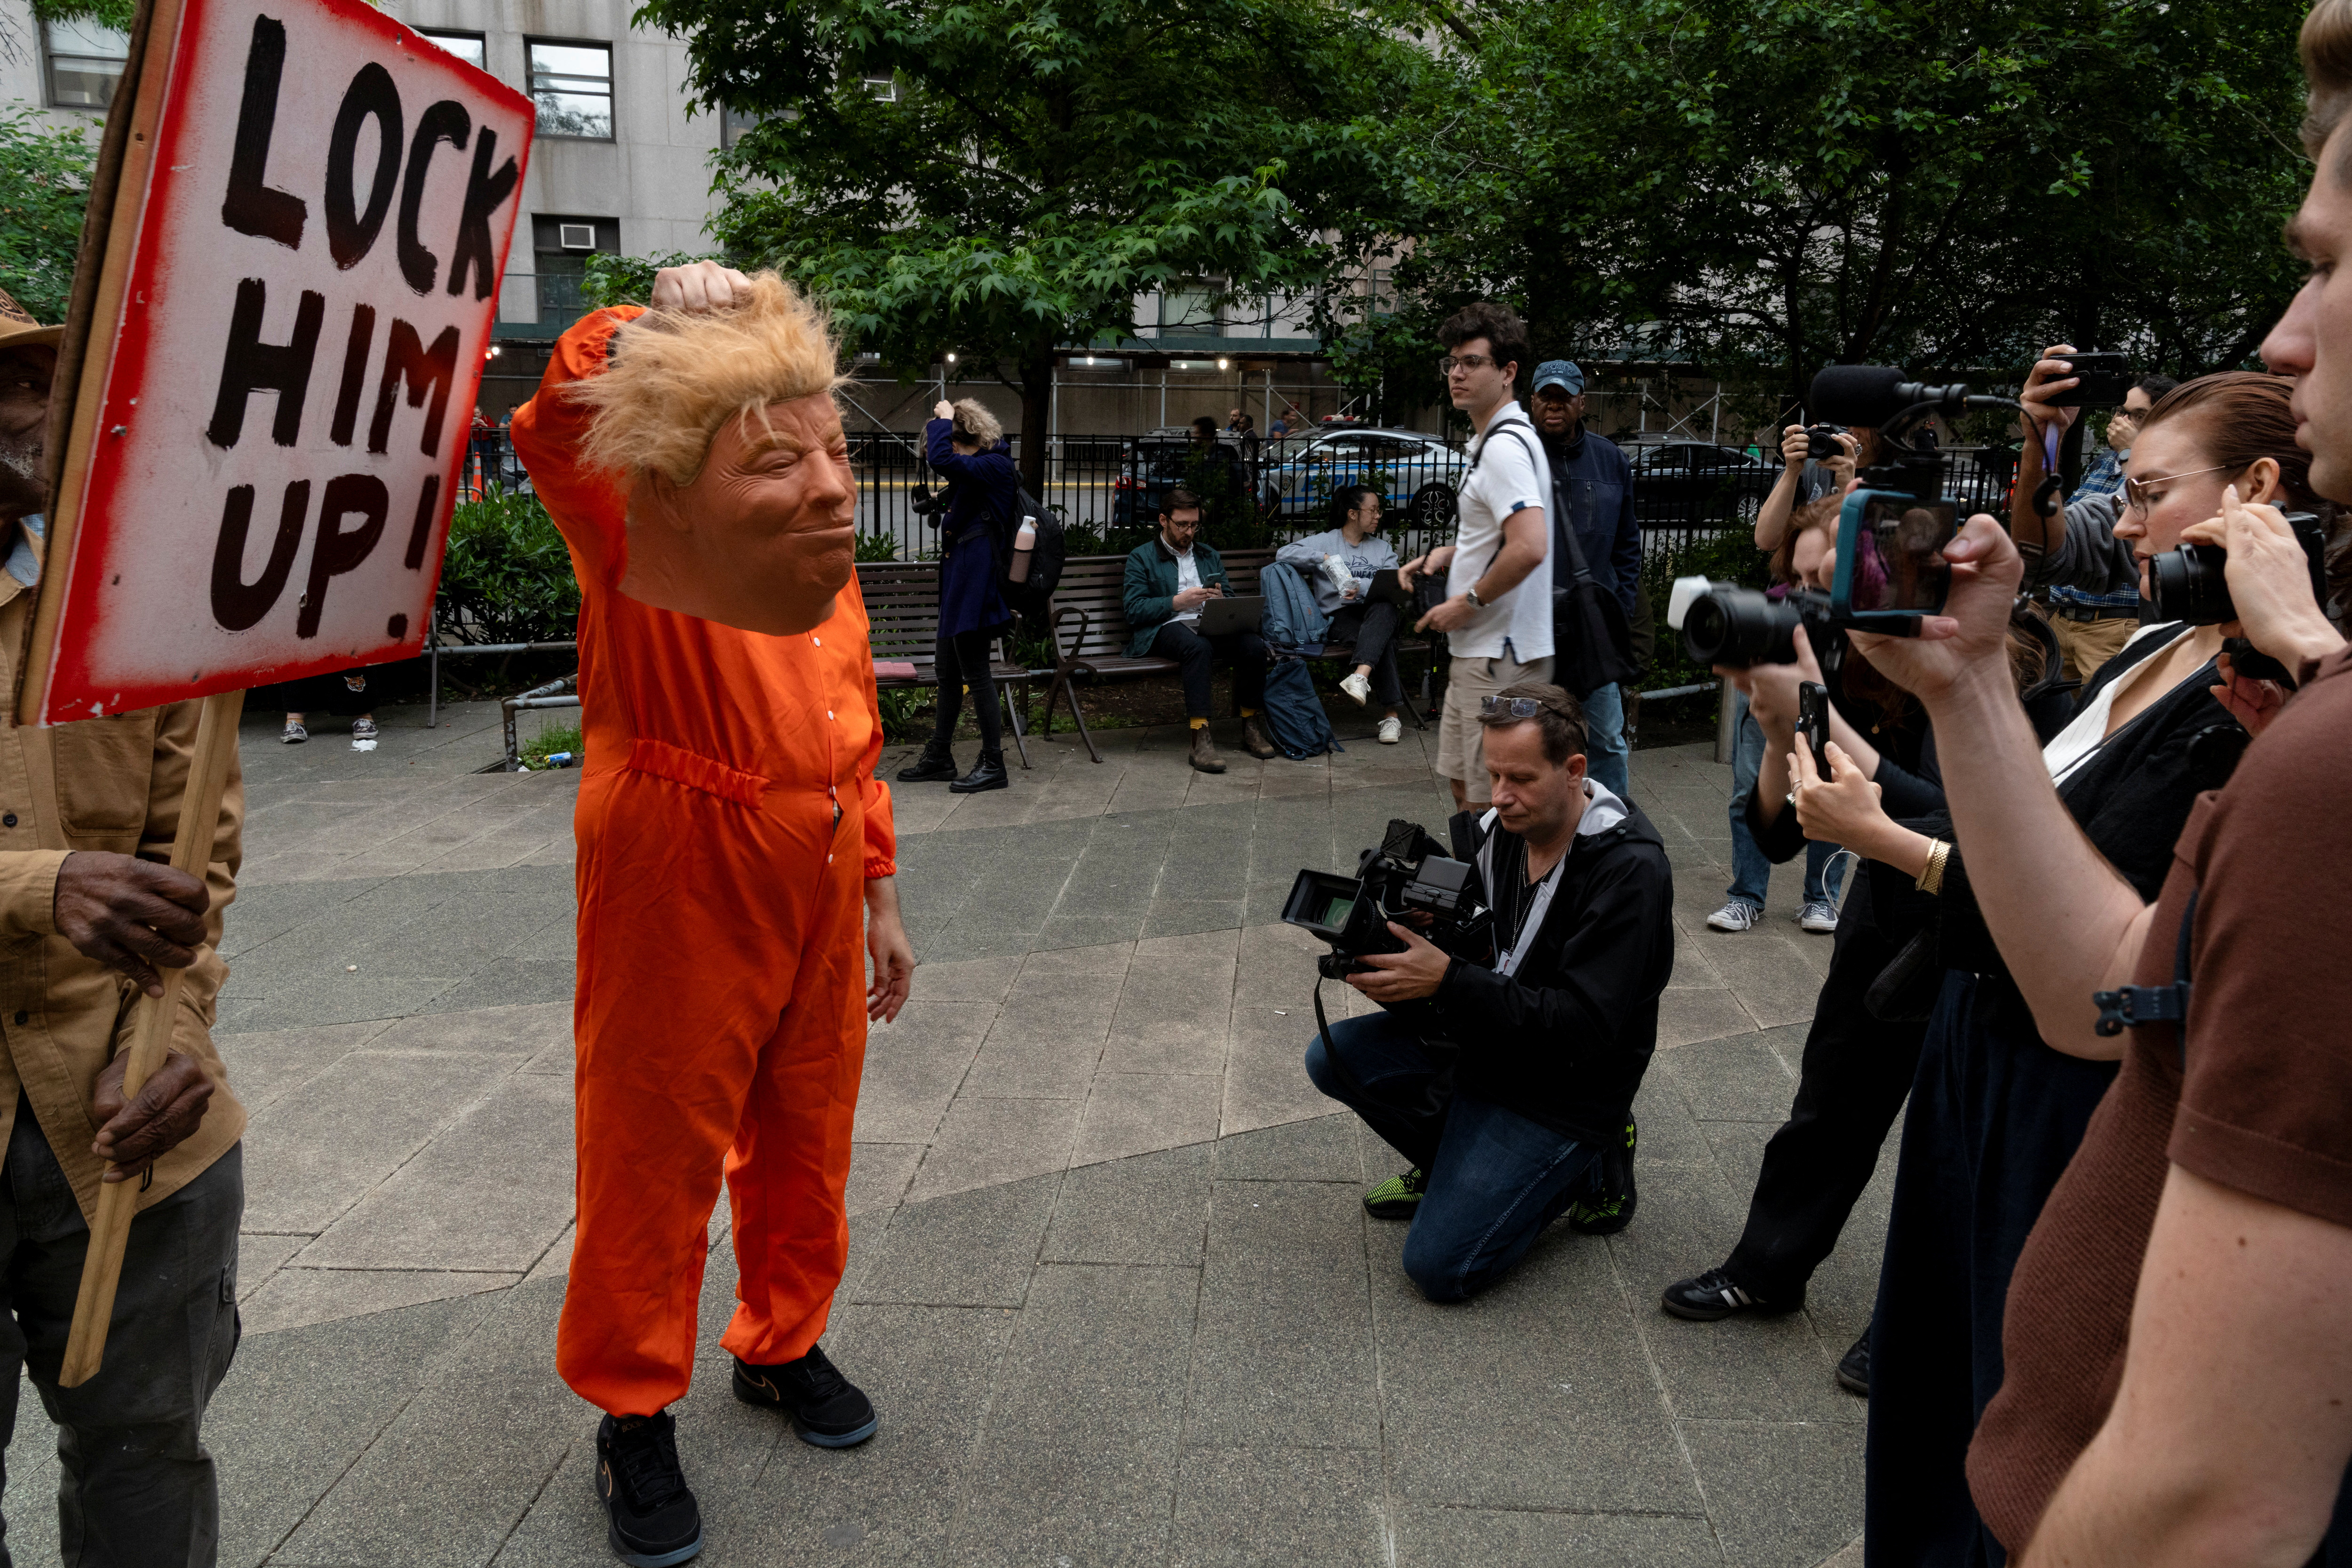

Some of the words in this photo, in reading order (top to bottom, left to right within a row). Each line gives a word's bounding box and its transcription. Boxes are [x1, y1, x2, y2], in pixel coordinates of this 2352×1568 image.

[222, 13, 518, 302] LOCK
[206, 278, 460, 458] HIM
[1544, 364, 1556, 374] NEW
[1557, 364, 1572, 374] YORK
[211, 474, 440, 639] UP!
